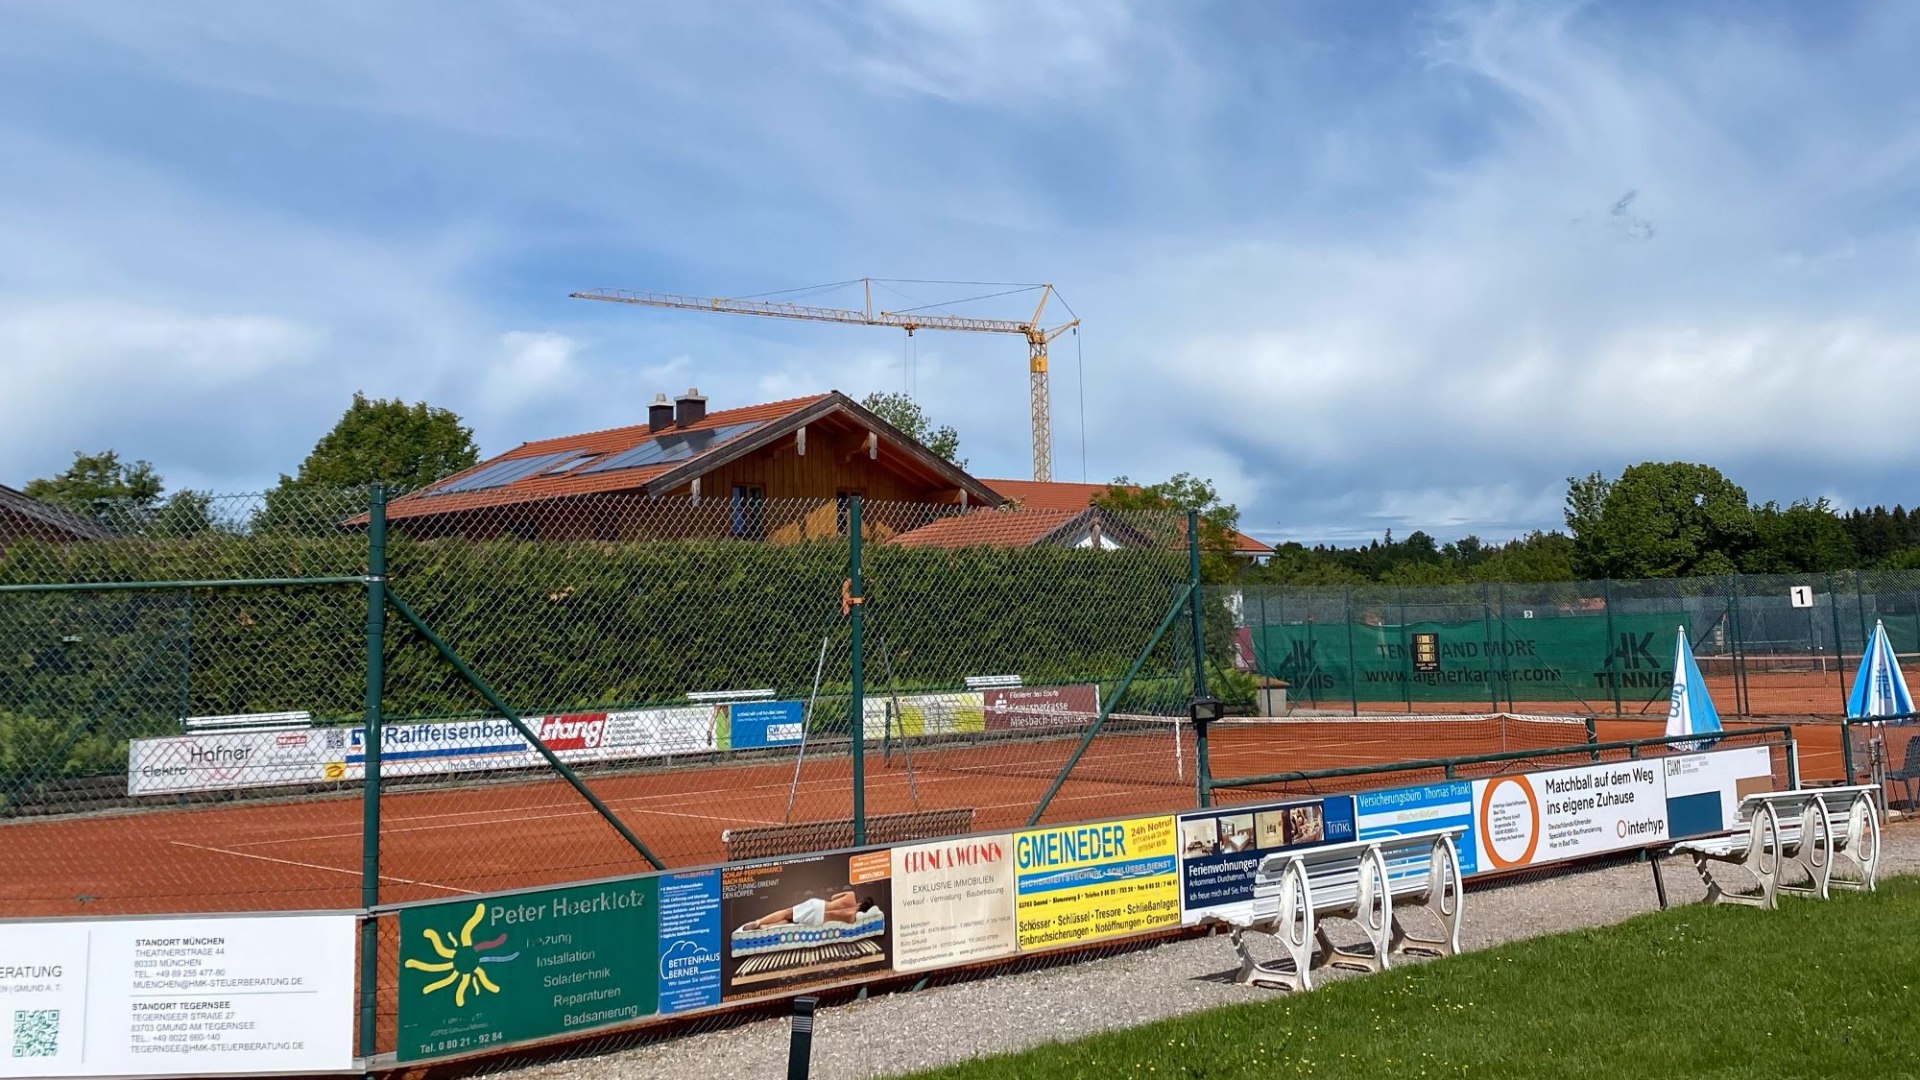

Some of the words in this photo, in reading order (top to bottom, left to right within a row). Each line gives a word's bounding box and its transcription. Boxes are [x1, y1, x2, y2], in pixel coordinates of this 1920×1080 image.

[1796, 588, 1804, 605] 1
[1526, 611, 1531, 619] 2
[1378, 644, 1413, 660] TEN
[1442, 642, 1478, 658] AND
[1483, 640, 1536, 658] MORE
[540, 718, 604, 748] stang
[190, 745, 252, 763] Hafner
[142, 766, 187, 778] Elektro
[1546, 774, 1592, 795] Matchball
[1594, 772, 1609, 787] auf
[1611, 771, 1631, 786] dem
[1632, 767, 1654, 785] Weg
[1359, 789, 1422, 808] Versicherungsbüro
[1424, 788, 1449, 799] Thomas
[1450, 785, 1471, 796] Prankl
[1547, 800, 1561, 815] ins
[1562, 797, 1594, 815] eigene
[1596, 792, 1635, 808] Zuhause
[1131, 826, 1146, 837] 24h
[1148, 820, 1172, 832] Notruf
[1627, 818, 1664, 836] interhyp
[1017, 826, 1126, 869] GMEINEDER
[904, 850, 945, 874] GRUND
[956, 842, 1002, 867] WOHNEN
[1107, 861, 1171, 876] SCHLÜSSELDIENST
[1189, 858, 1258, 877] Ferienwohnungen
[913, 880, 952, 894] EXKLUSIVE
[954, 876, 994, 888] IMMOBILIEN
[1198, 892, 1211, 900] freue
[1223, 888, 1231, 896] auf
[723, 892, 733, 900] DEN
[903, 897, 925, 907] Verkauf
[930, 893, 962, 903] Vermietung
[966, 887, 1004, 898] Baubetreuung
[491, 904, 546, 926] Peter
[553, 890, 645, 918] Heerklotz
[1058, 911, 1090, 926] Schlüssel
[1094, 908, 1121, 920] Tresore
[1127, 900, 1178, 915] Schließanlagen
[1019, 927, 1089, 946] Einbruchsicherungen
[1095, 918, 1142, 933] Notöffnungen
[1146, 913, 1179, 925] Gravuren
[135, 938, 180, 947] STANDORT
[183, 937, 225, 946] MÜNCHEN
[160, 959, 202, 967] MÜNCHEN
[536, 950, 596, 968] Installation
[669, 953, 720, 969] BETTENHAUS
[544, 968, 611, 988] Solartechnik
[669, 967, 699, 979] BERNER
[133, 978, 303, 990] MUENCHEN@HMK-STEUERBERATUNG.DE
[132, 1002, 177, 1011] STANDORT
[180, 1001, 231, 1010] TEGERNSEE
[554, 988, 621, 1007] Reparaturen
[132, 1013, 188, 1022] TEGERNSEER
[225, 1012, 235, 1020] 27
[564, 1005, 638, 1026] Badsanierung
[156, 1023, 188, 1032] GMUND
[189, 1023, 202, 1031] AM
[204, 1022, 256, 1031] TEGERNSEE
[130, 1042, 305, 1054] TEGERNSEE@HMK-STEUERBERATUNG.DE
[420, 1044, 436, 1054] Tel.
[438, 1042, 445, 1050] 0
[446, 1040, 458, 1049] 80
[460, 1038, 470, 1047] 21
[478, 1034, 490, 1044] 92
[492, 1032, 503, 1041] 84
